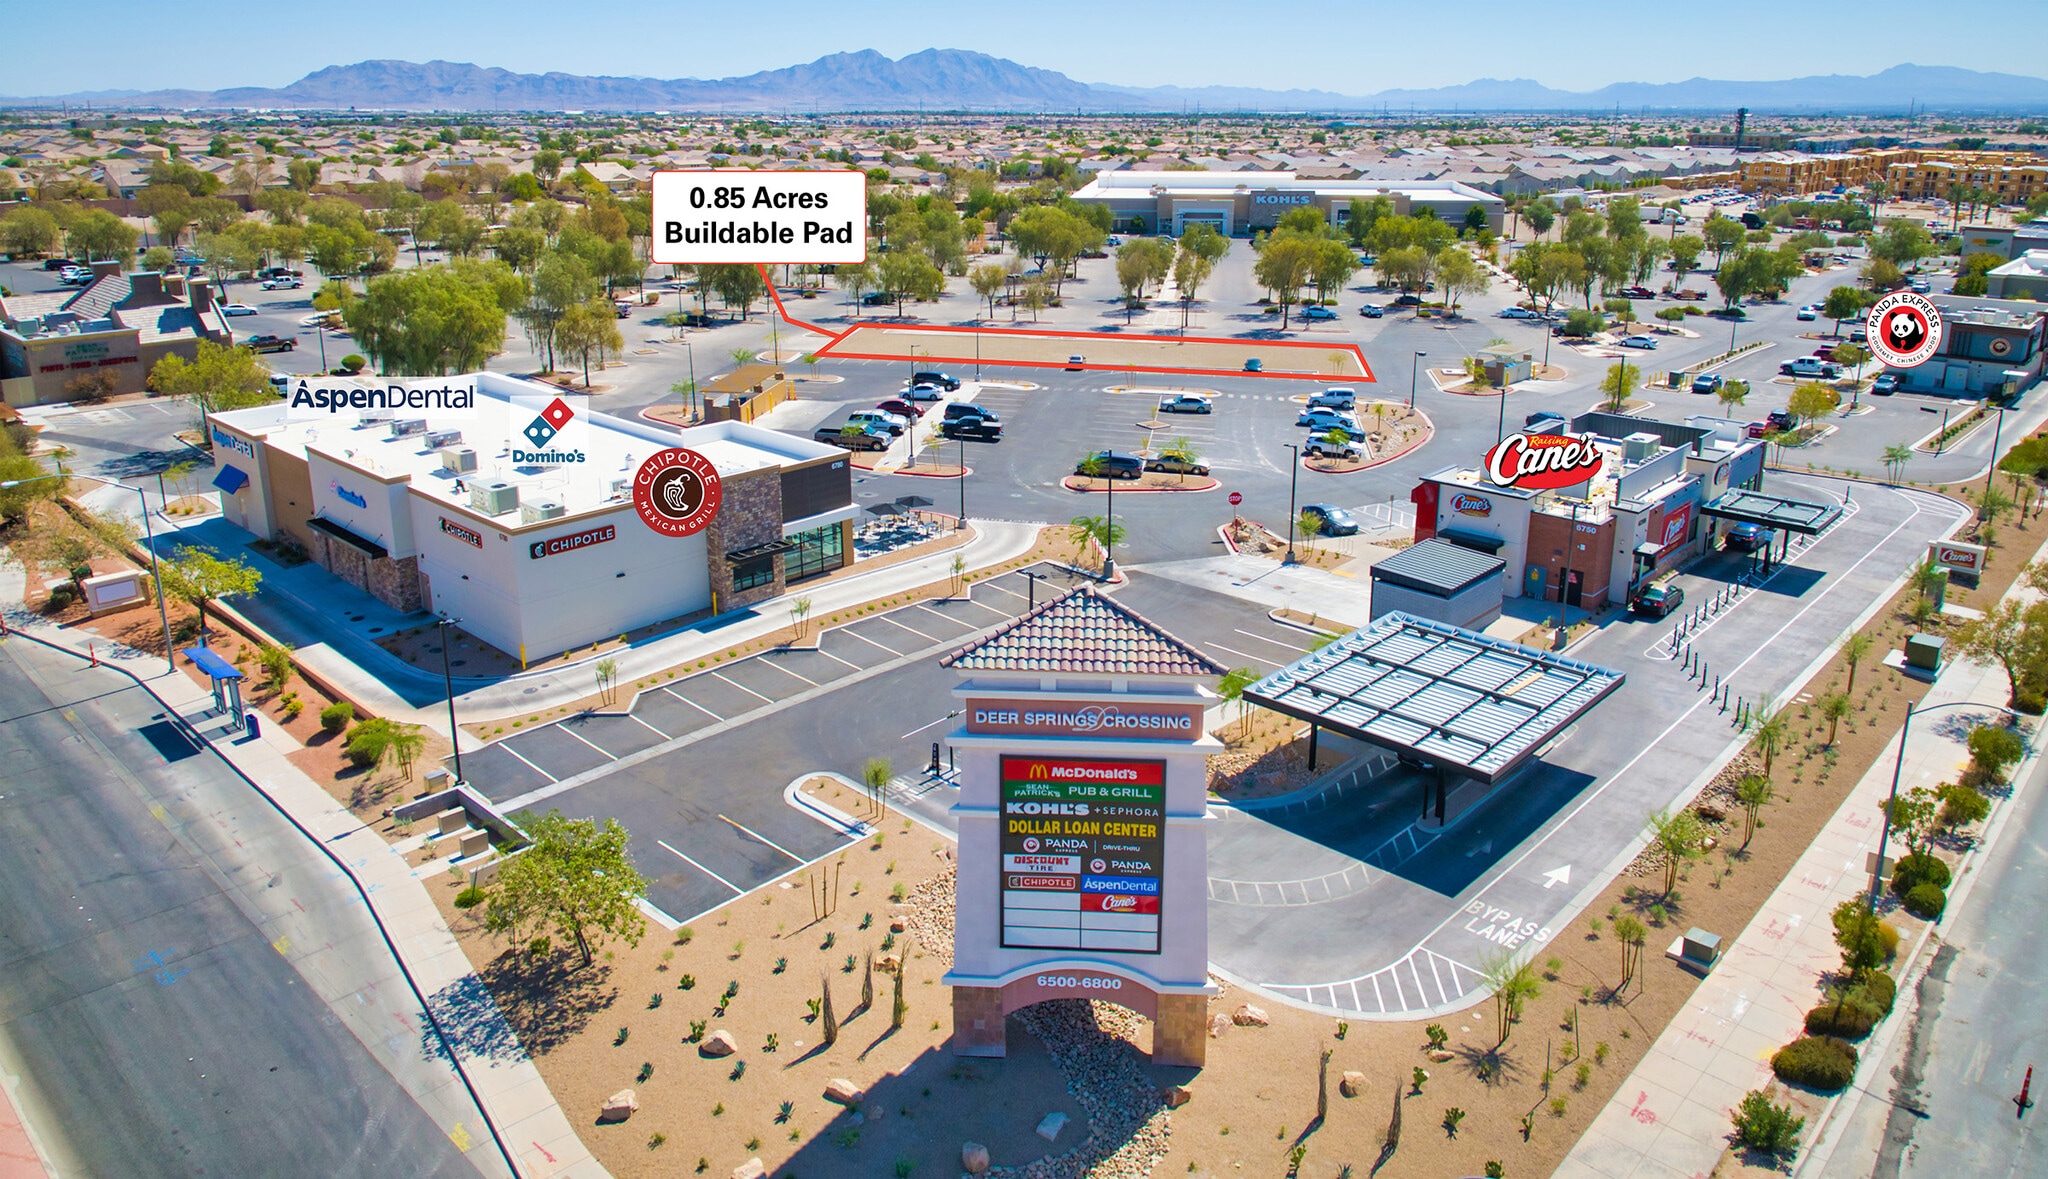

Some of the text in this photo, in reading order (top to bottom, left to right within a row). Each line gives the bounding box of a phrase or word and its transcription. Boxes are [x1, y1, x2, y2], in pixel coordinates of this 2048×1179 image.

[1255, 195, 1310, 205] KOHL'S
[1451, 493, 1491, 512] Cane's
[445, 523, 480, 546] CHIPOTLE
[1575, 524, 1597, 535] 6750
[550, 528, 614, 552] CHIPOTLE
[975, 709, 1192, 729] DEER SPRINGS CROSSING
[1051, 767, 1138, 780] McDonald's
[1014, 789, 1061, 798] PATRICK'S
[1068, 786, 1152, 798] PUB & GRILL
[1006, 801, 1090, 816] KOHL'S
[1103, 806, 1159, 817] SEPHORA
[1009, 819, 1157, 838] DOLLAR LOAN CENTER
[1045, 838, 1088, 849] PANDA
[1103, 844, 1141, 852] DRIVE-THRU
[1013, 855, 1070, 866] DISCOUNT
[1111, 860, 1152, 870] PANDA
[1024, 876, 1072, 887] CHIPOTLE
[1084, 878, 1157, 892] AspenDental
[1101, 894, 1137, 911] Cane's
[1464, 900, 1552, 942] BYPASS
[1463, 917, 1526, 949] LANE
[1037, 975, 1122, 990] 6500-6800
